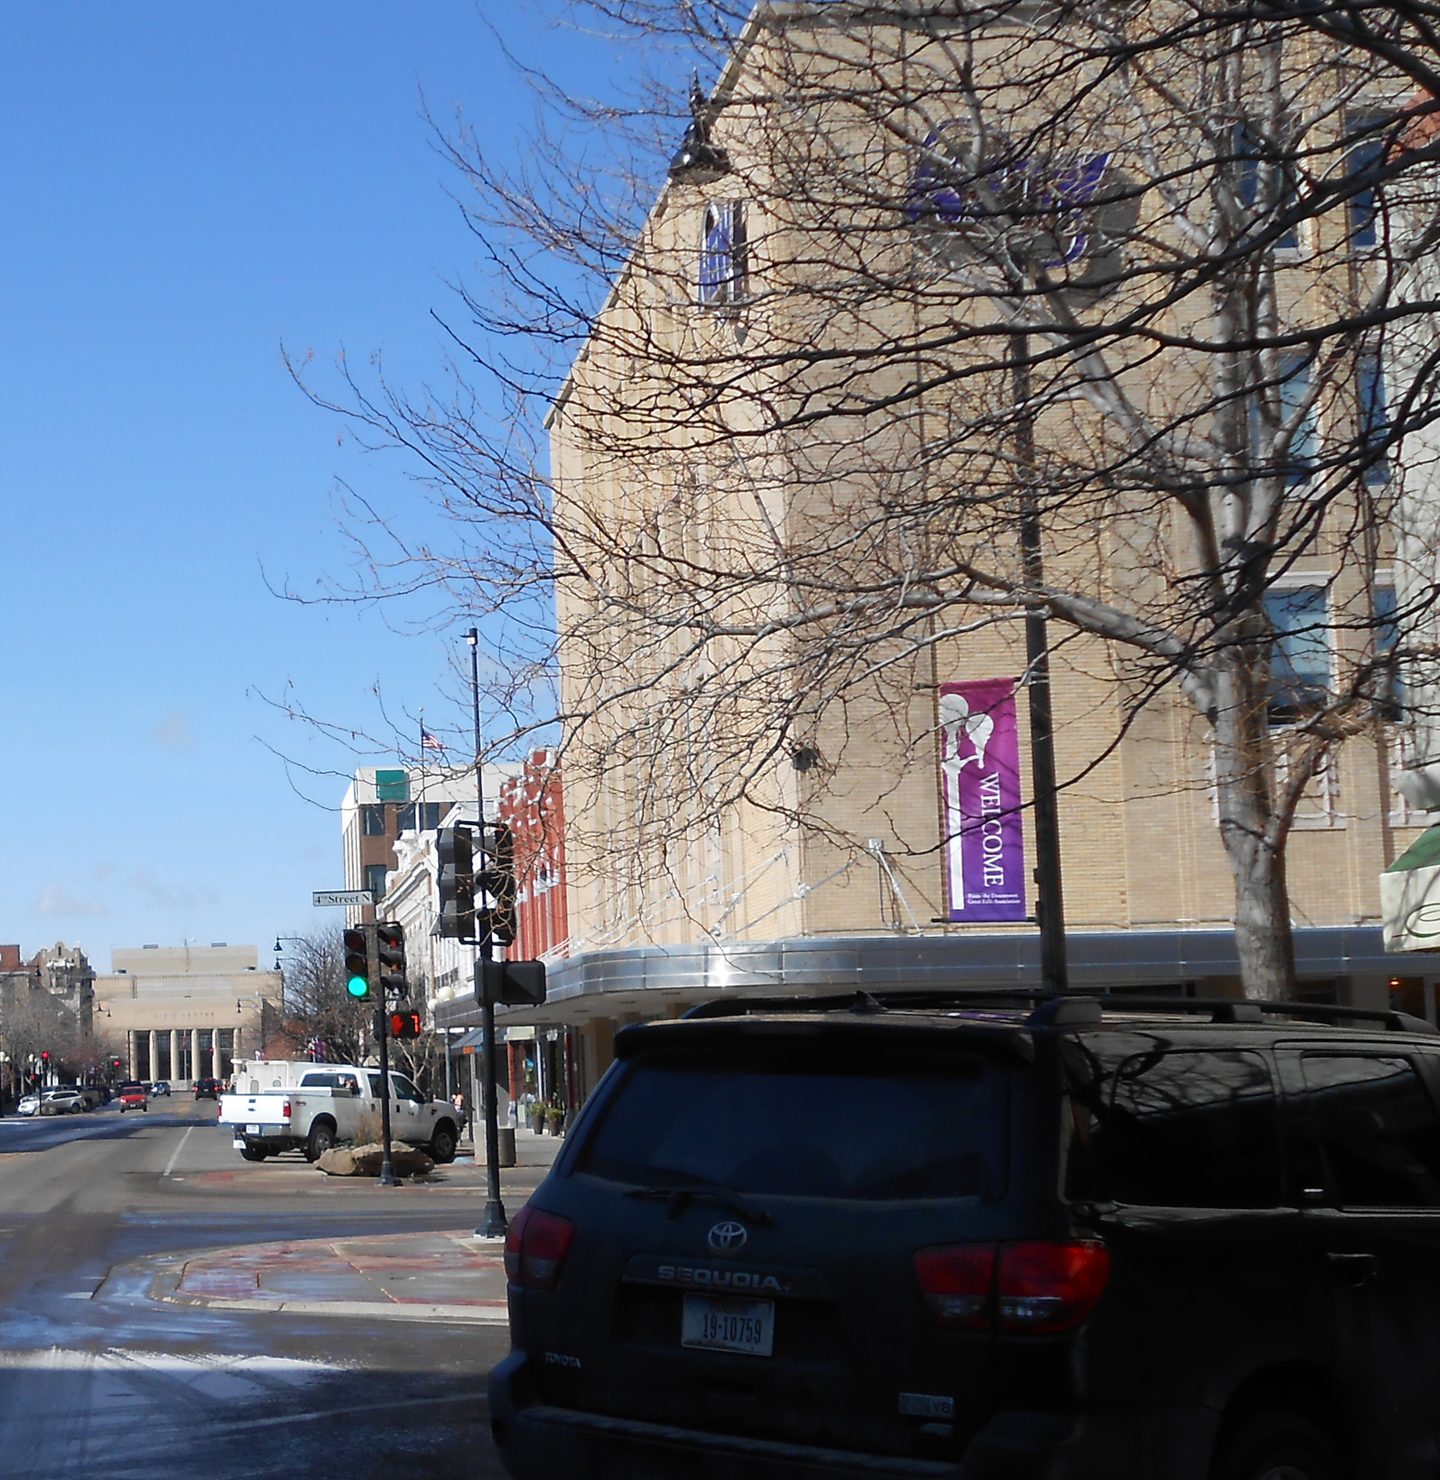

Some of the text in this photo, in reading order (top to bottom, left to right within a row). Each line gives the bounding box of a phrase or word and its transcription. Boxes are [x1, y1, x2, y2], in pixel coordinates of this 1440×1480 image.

[980, 771, 1004, 887] WELCOME
[328, 895, 359, 904] Street
[362, 893, 370, 902] N
[657, 1265, 782, 1291] SEQUOIA
[702, 1313, 762, 1344] 19-10759
